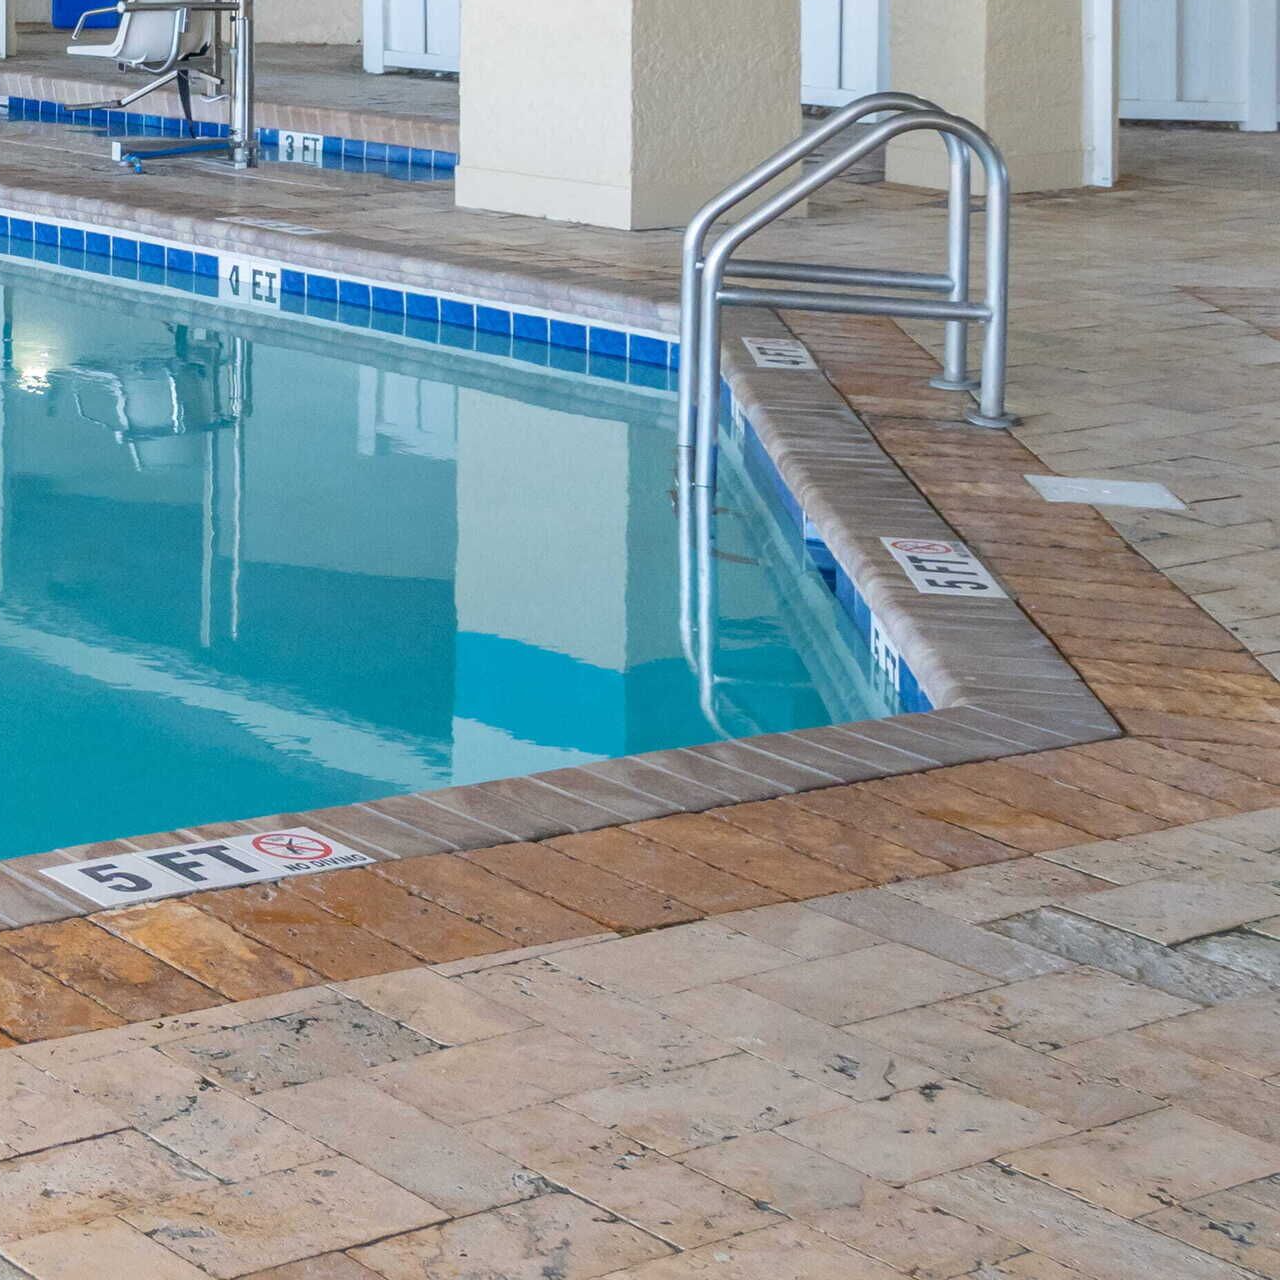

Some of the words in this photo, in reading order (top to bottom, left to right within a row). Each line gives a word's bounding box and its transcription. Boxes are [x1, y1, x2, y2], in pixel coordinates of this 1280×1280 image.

[906, 555, 978, 576] FT
[925, 579, 989, 590] 5
[78, 863, 153, 893] 5
[146, 845, 260, 882] FT
[283, 862, 311, 872] NO
[310, 853, 368, 868] DIVING
